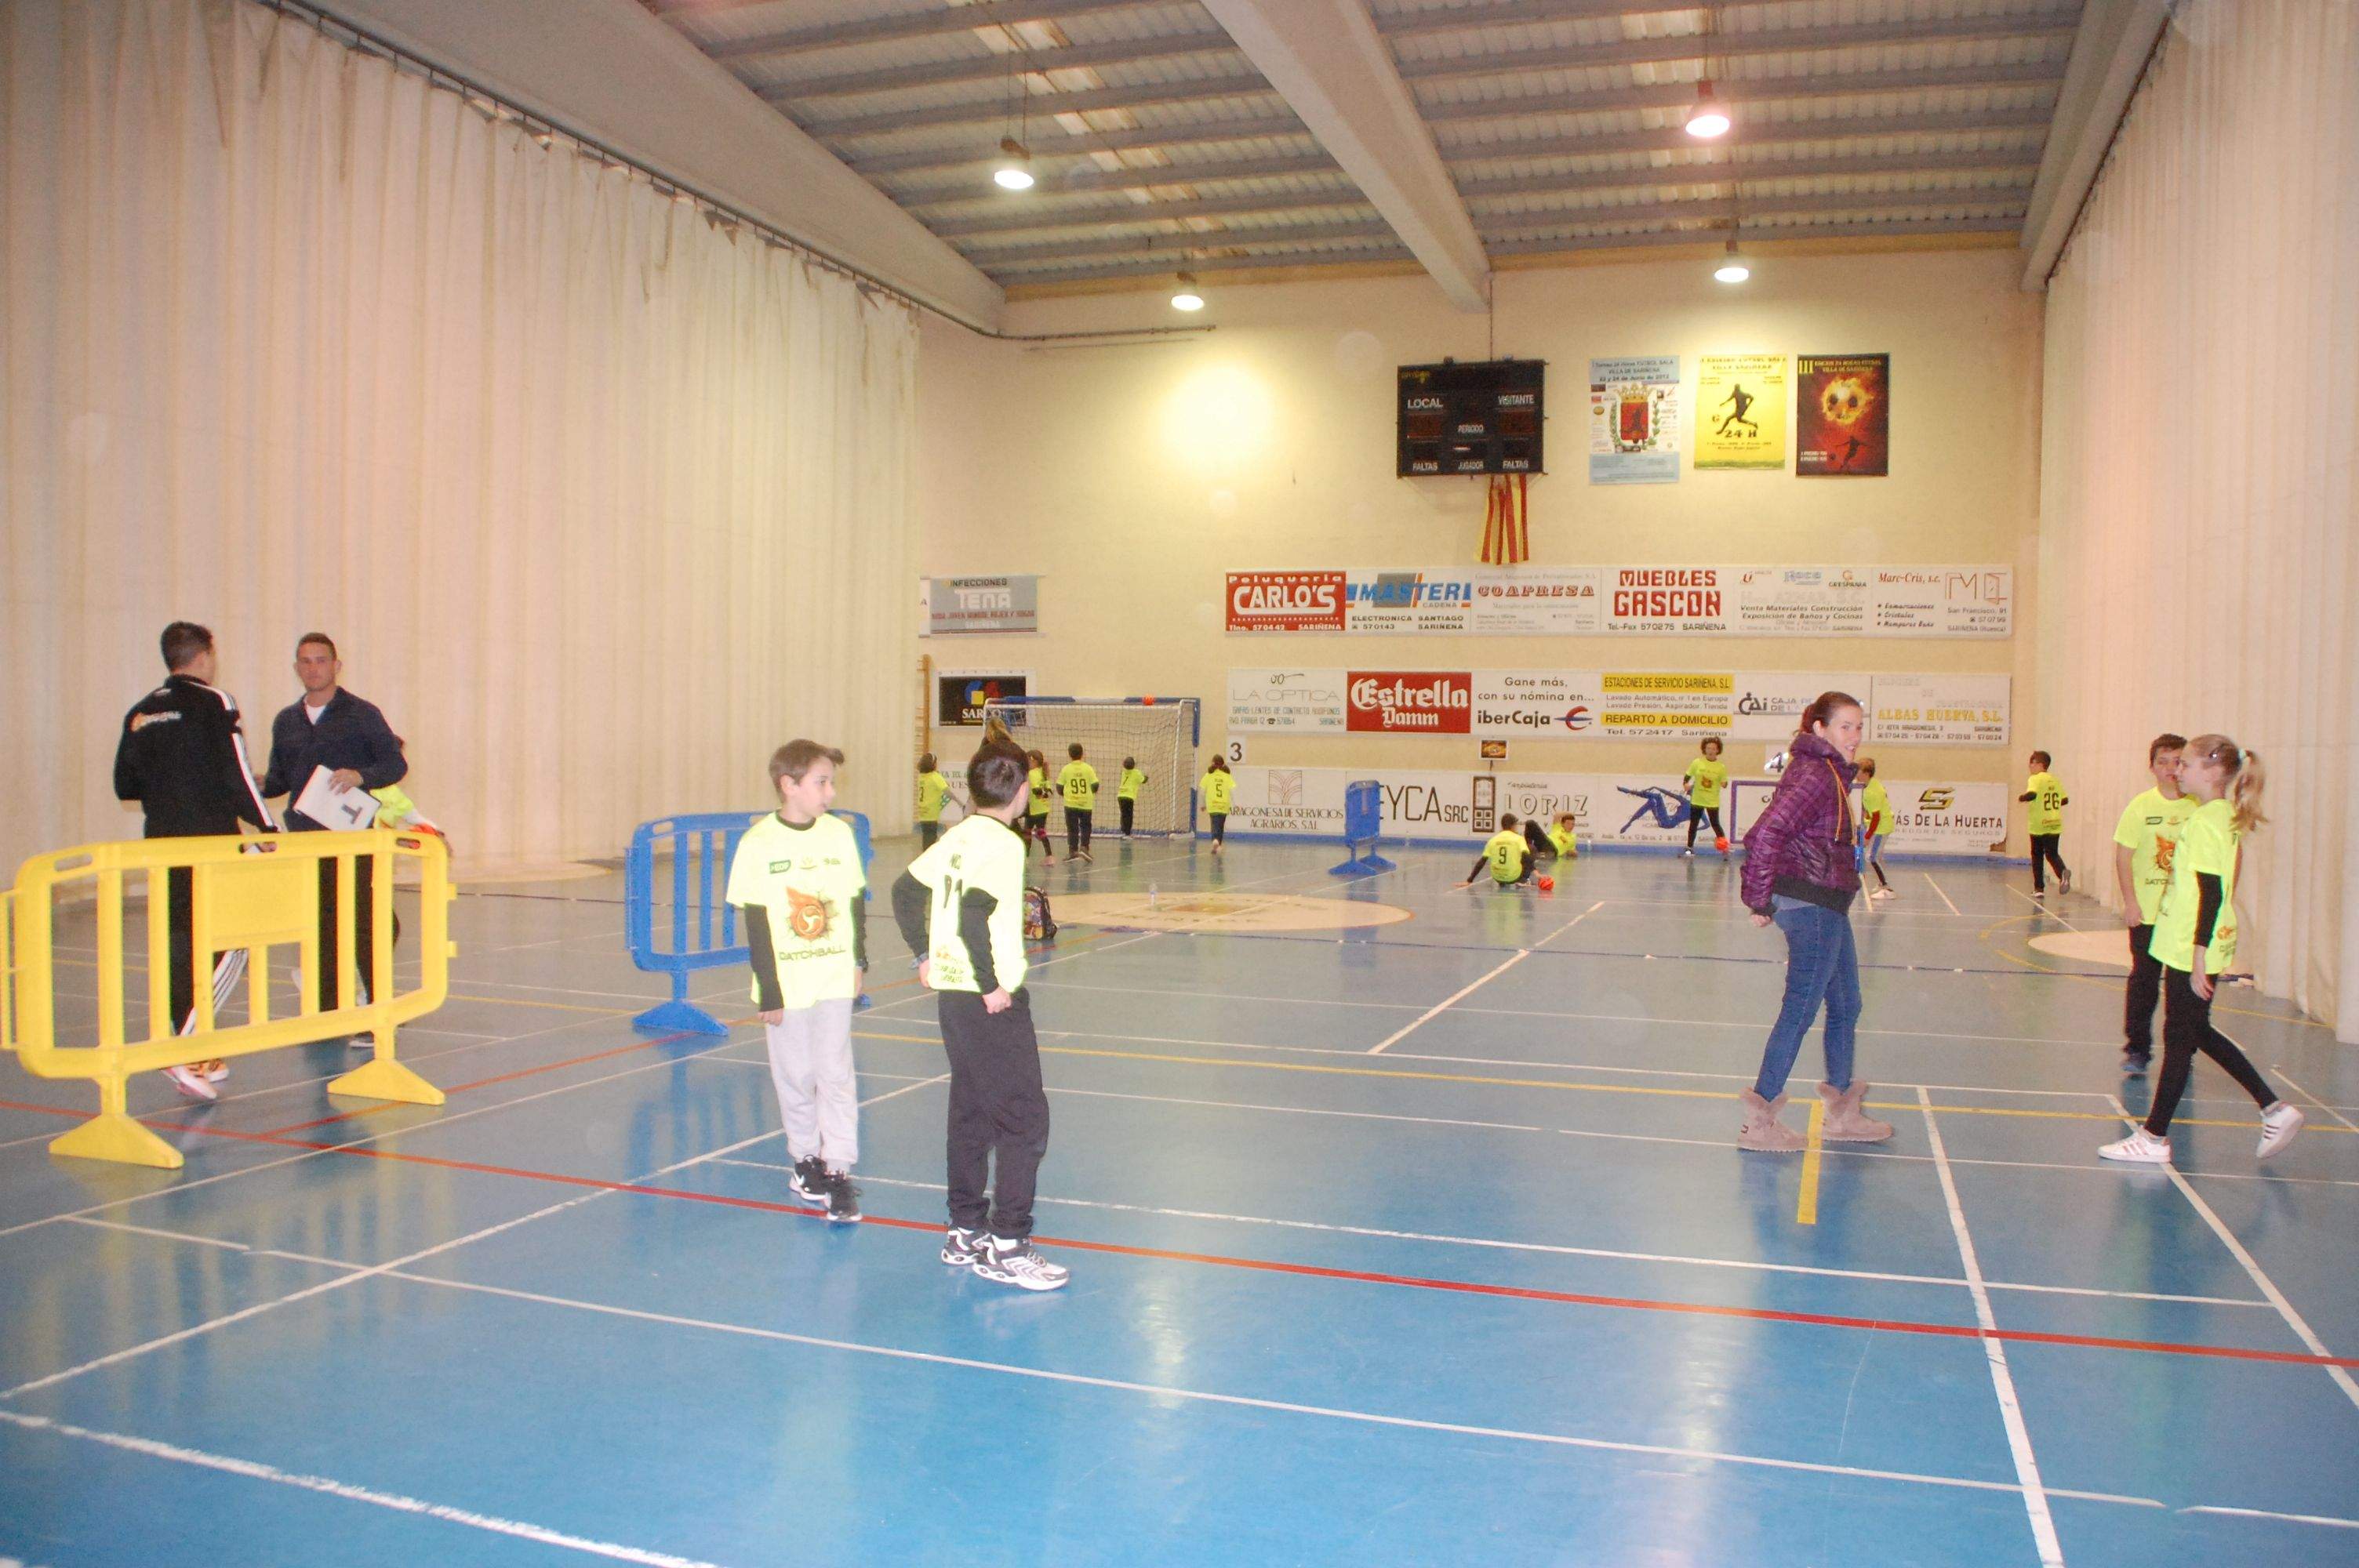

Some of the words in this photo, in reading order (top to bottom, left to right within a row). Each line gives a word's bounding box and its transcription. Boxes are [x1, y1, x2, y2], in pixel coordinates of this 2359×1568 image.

[1408, 397, 1444, 408] LOCAL
[1498, 394, 1535, 405] VISITANTE
[1725, 429, 1742, 438] 24
[1412, 462, 1438, 471] FALTAS
[1503, 460, 1528, 470] FALTAS
[1619, 570, 1716, 586] MUEBLES
[1478, 585, 1595, 597] COAPRESA
[1234, 585, 1336, 615] CARLO'S
[1614, 590, 1721, 617] GASCON
[1682, 622, 1727, 630] SARIÑENA
[1504, 677, 1536, 687] Gane
[1605, 677, 1643, 688] ESTACIONES
[1644, 677, 1653, 688] DE
[1654, 677, 1683, 688] SERVICIO
[1233, 689, 1262, 702] LA
[1350, 677, 1470, 710] Estrella
[1520, 690, 1565, 702] nómina
[1703, 695, 1728, 703] Europa
[1381, 706, 1439, 728] Damm
[1477, 710, 1550, 728] iberCaja
[1605, 714, 1656, 724] REPARTO
[1660, 715, 1668, 724] A
[1671, 715, 1728, 725] DOMICILIO
[1229, 742, 1243, 762] 3
[1770, 753, 1784, 773] 4
[1070, 778, 1087, 795] 99
[1380, 785, 1442, 822] YCA
[1444, 804, 1469, 823] SRC
[2043, 792, 2061, 812] 26
[1228, 807, 1283, 817] ARAGONESA
[1284, 808, 1293, 817] DE
[1295, 808, 1344, 819] SERVICIOS
[1954, 814, 2004, 829] HUERTA
